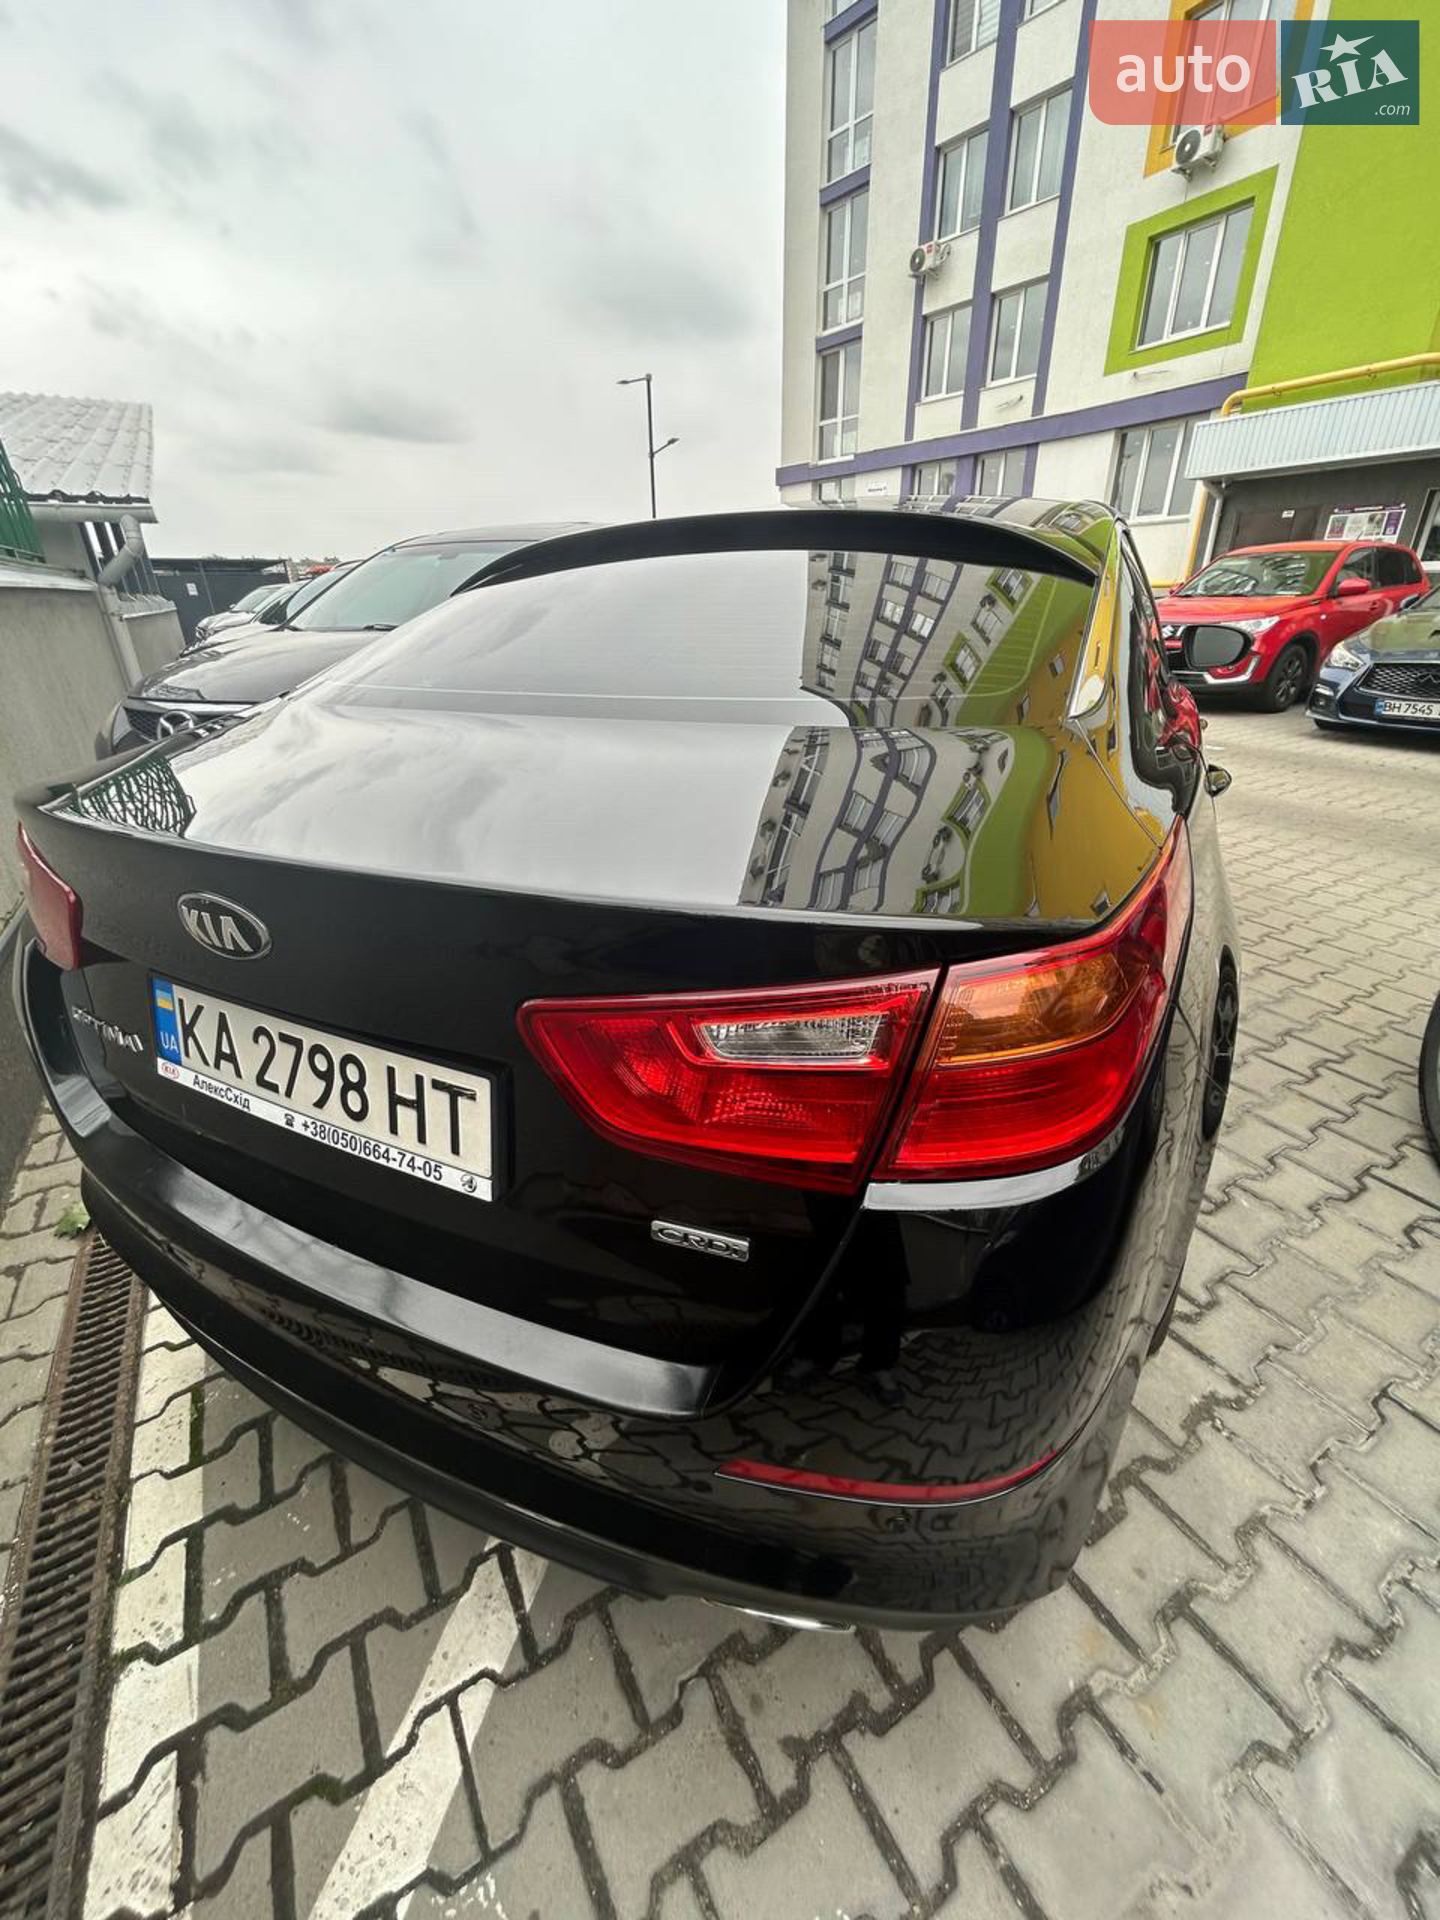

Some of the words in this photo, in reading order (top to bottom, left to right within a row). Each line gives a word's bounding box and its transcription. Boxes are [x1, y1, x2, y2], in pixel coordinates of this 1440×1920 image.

[1404, 703, 1434, 715] 7545
[181, 905, 254, 952] KIA
[160, 1031, 179, 1053] UA
[178, 998, 243, 1079] KA
[252, 1025, 370, 1122] 2798
[386, 1065, 477, 1156] HT
[193, 1075, 251, 1111] АлексСхід
[301, 1121, 443, 1181] +38(050)664-74-05
